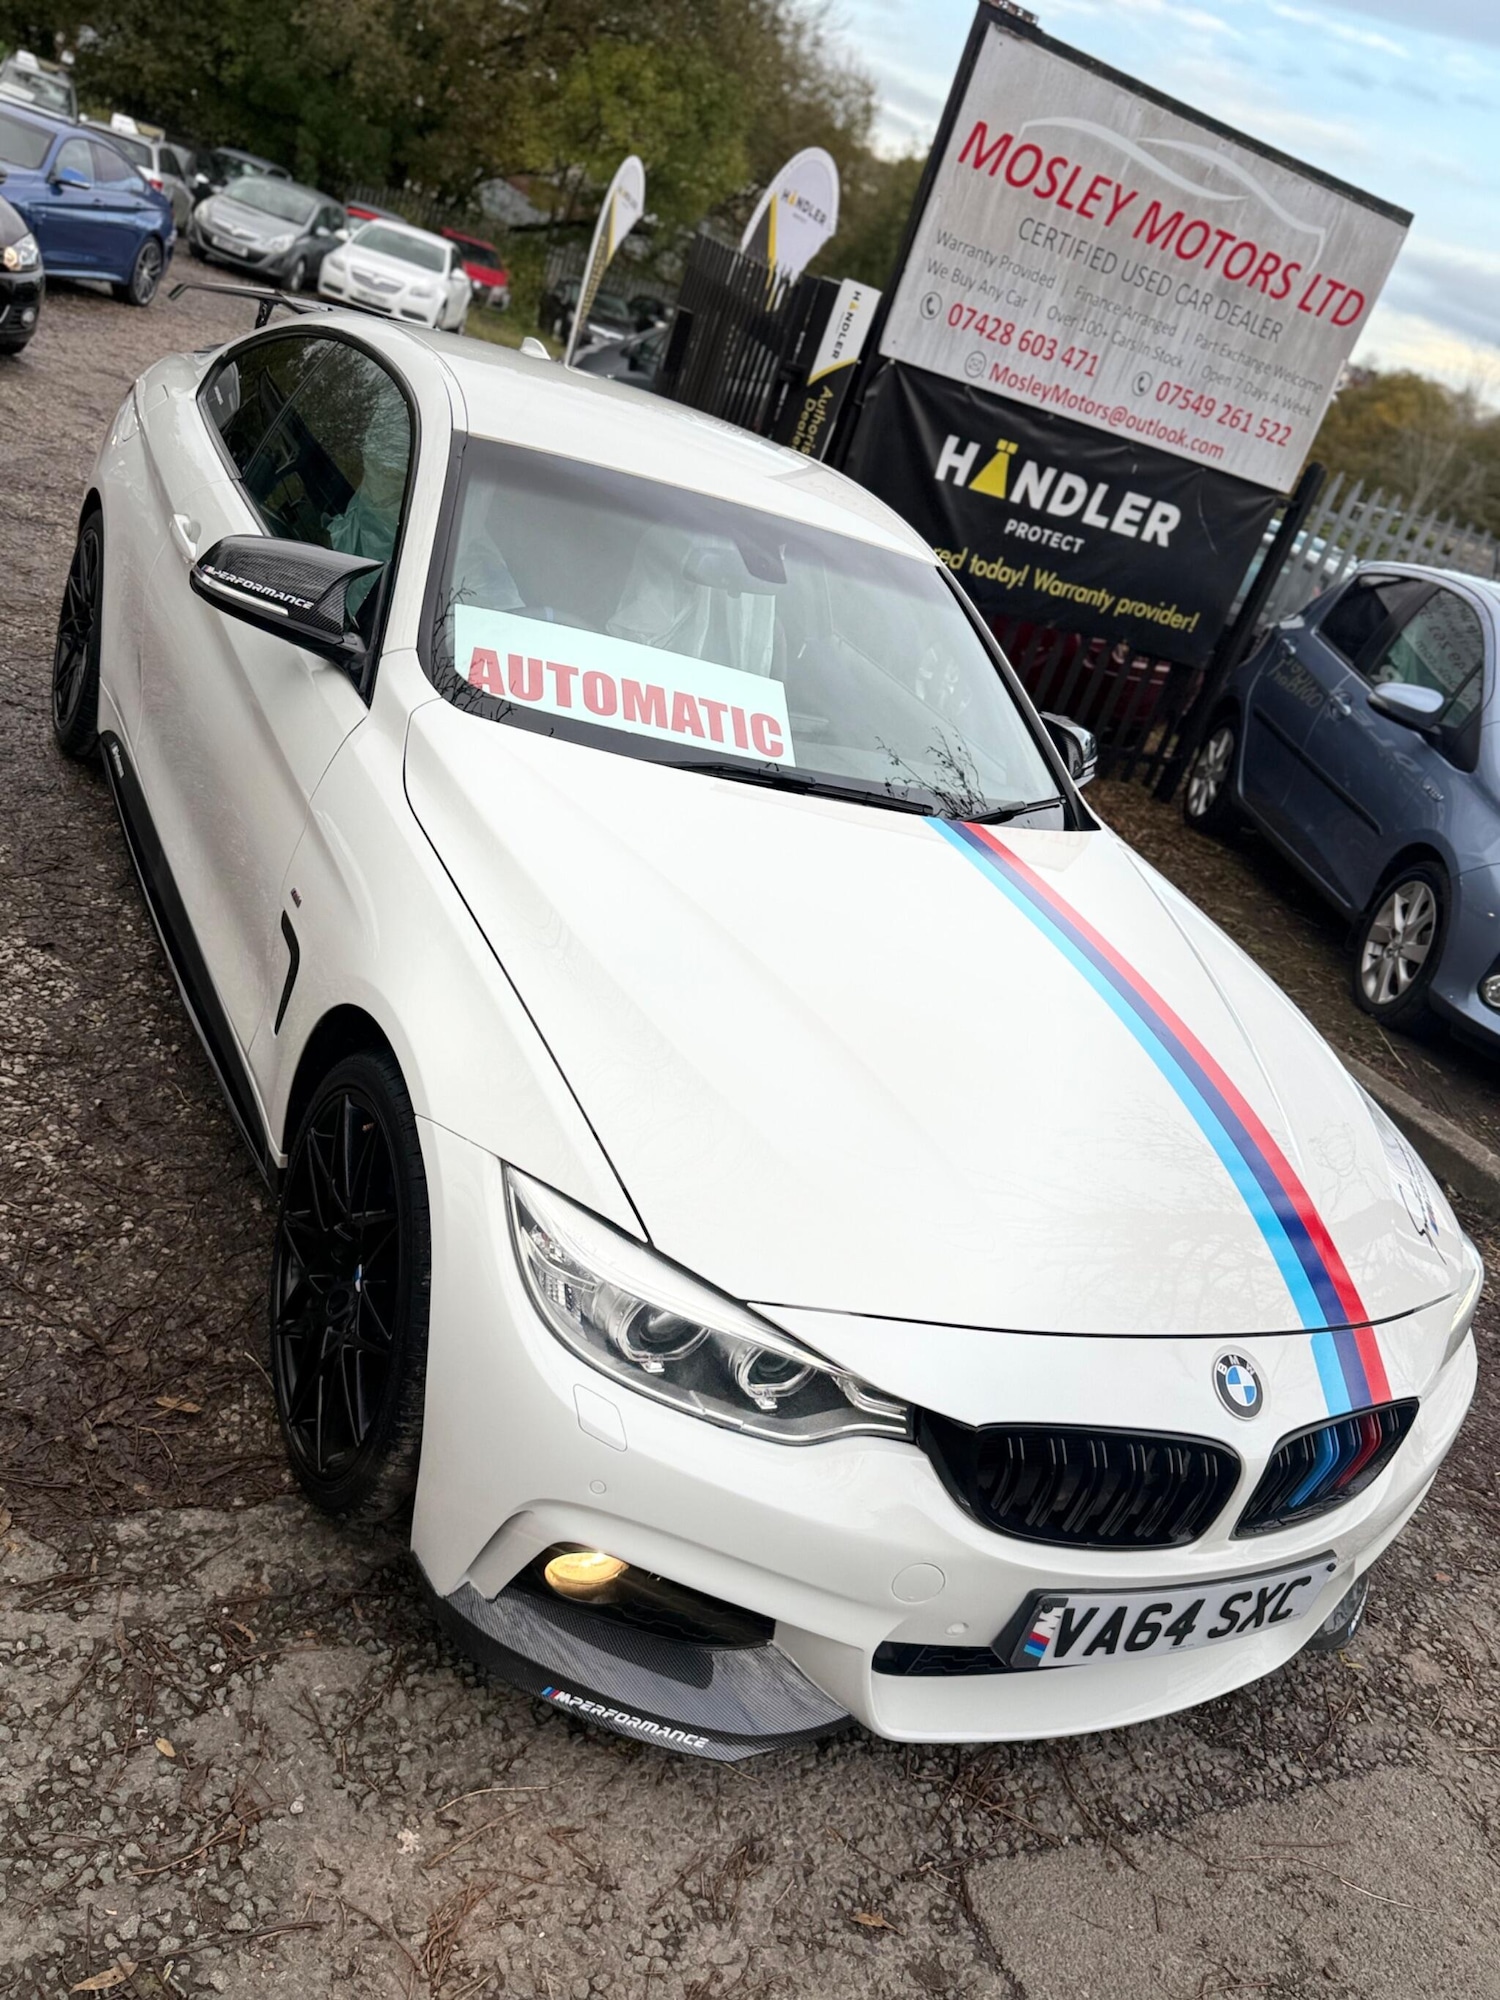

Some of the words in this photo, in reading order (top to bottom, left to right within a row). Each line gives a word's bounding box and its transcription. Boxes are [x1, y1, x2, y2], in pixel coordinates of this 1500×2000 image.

[957, 121, 1139, 228] MOSLEY
[1132, 200, 1302, 302] MOTORS
[1296, 273, 1366, 328] LTD
[936, 229, 998, 269] Warranty
[1000, 254, 1057, 290] Provided
[1074, 284, 1123, 316] Finance
[1123, 304, 1178, 338] Arranged
[1193, 333, 1219, 352] Part
[1219, 343, 1273, 377] Exchange
[1272, 366, 1324, 395] Welcome
[1018, 217, 1118, 275] CERTIFIED
[1120, 260, 1173, 298] USED
[1174, 283, 1214, 316] CAR
[1214, 299, 1284, 344] DEALER
[926, 257, 949, 279] We
[950, 267, 976, 292] Buy
[977, 279, 1002, 303] Any
[1005, 290, 1028, 310] Car
[1046, 305, 1078, 327] Over
[1078, 317, 1109, 339] 100+
[1110, 330, 1137, 353] Cars
[1150, 345, 1185, 371] Stock
[1200, 365, 1233, 388] Open
[1234, 377, 1245, 391] 7
[1244, 381, 1269, 405] Days
[1280, 396, 1313, 418] Week
[947, 303, 1016, 346] 07428
[1017, 329, 1059, 361] 603
[1060, 346, 1100, 378] 471
[987, 362, 1225, 460] MosleyMotors@outlook.com
[1155, 381, 1217, 419] 07549
[1216, 403, 1254, 434] 261
[1255, 418, 1293, 448] 522
[934, 434, 1182, 548] HÄNDLER
[1003, 518, 1086, 554] PROTECT
[968, 551, 1031, 592] today!
[1033, 568, 1115, 615] Warranty
[1113, 596, 1201, 634] provider!
[467, 646, 785, 758] AUTOMATIC
[1053, 1598, 1206, 1658] VA64
[1207, 1575, 1312, 1640] SXC
